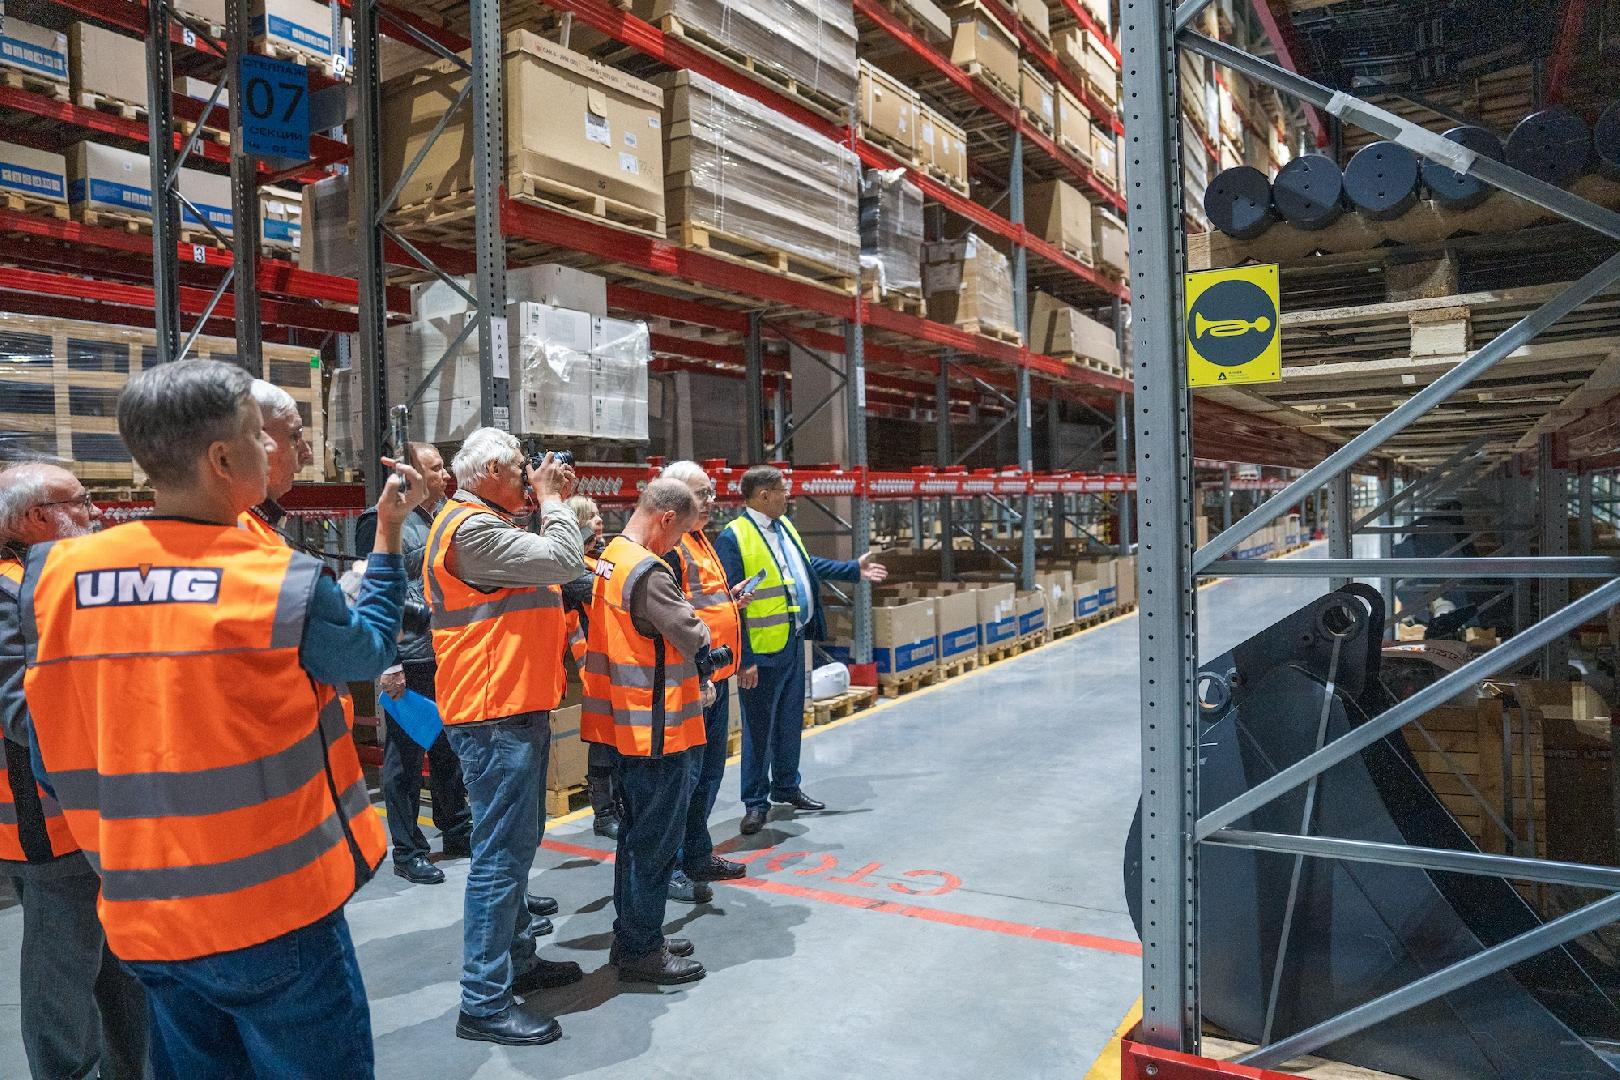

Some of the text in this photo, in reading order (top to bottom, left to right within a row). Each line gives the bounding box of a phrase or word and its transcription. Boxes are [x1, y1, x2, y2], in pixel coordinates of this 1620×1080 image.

[186, 29, 194, 45] 5
[335, 57, 345, 73] 5
[246, 77, 304, 122] 07
[250, 125, 303, 141] СЕКЦИИ
[196, 246, 204, 262] 3
[77, 569, 218, 607] UMG
